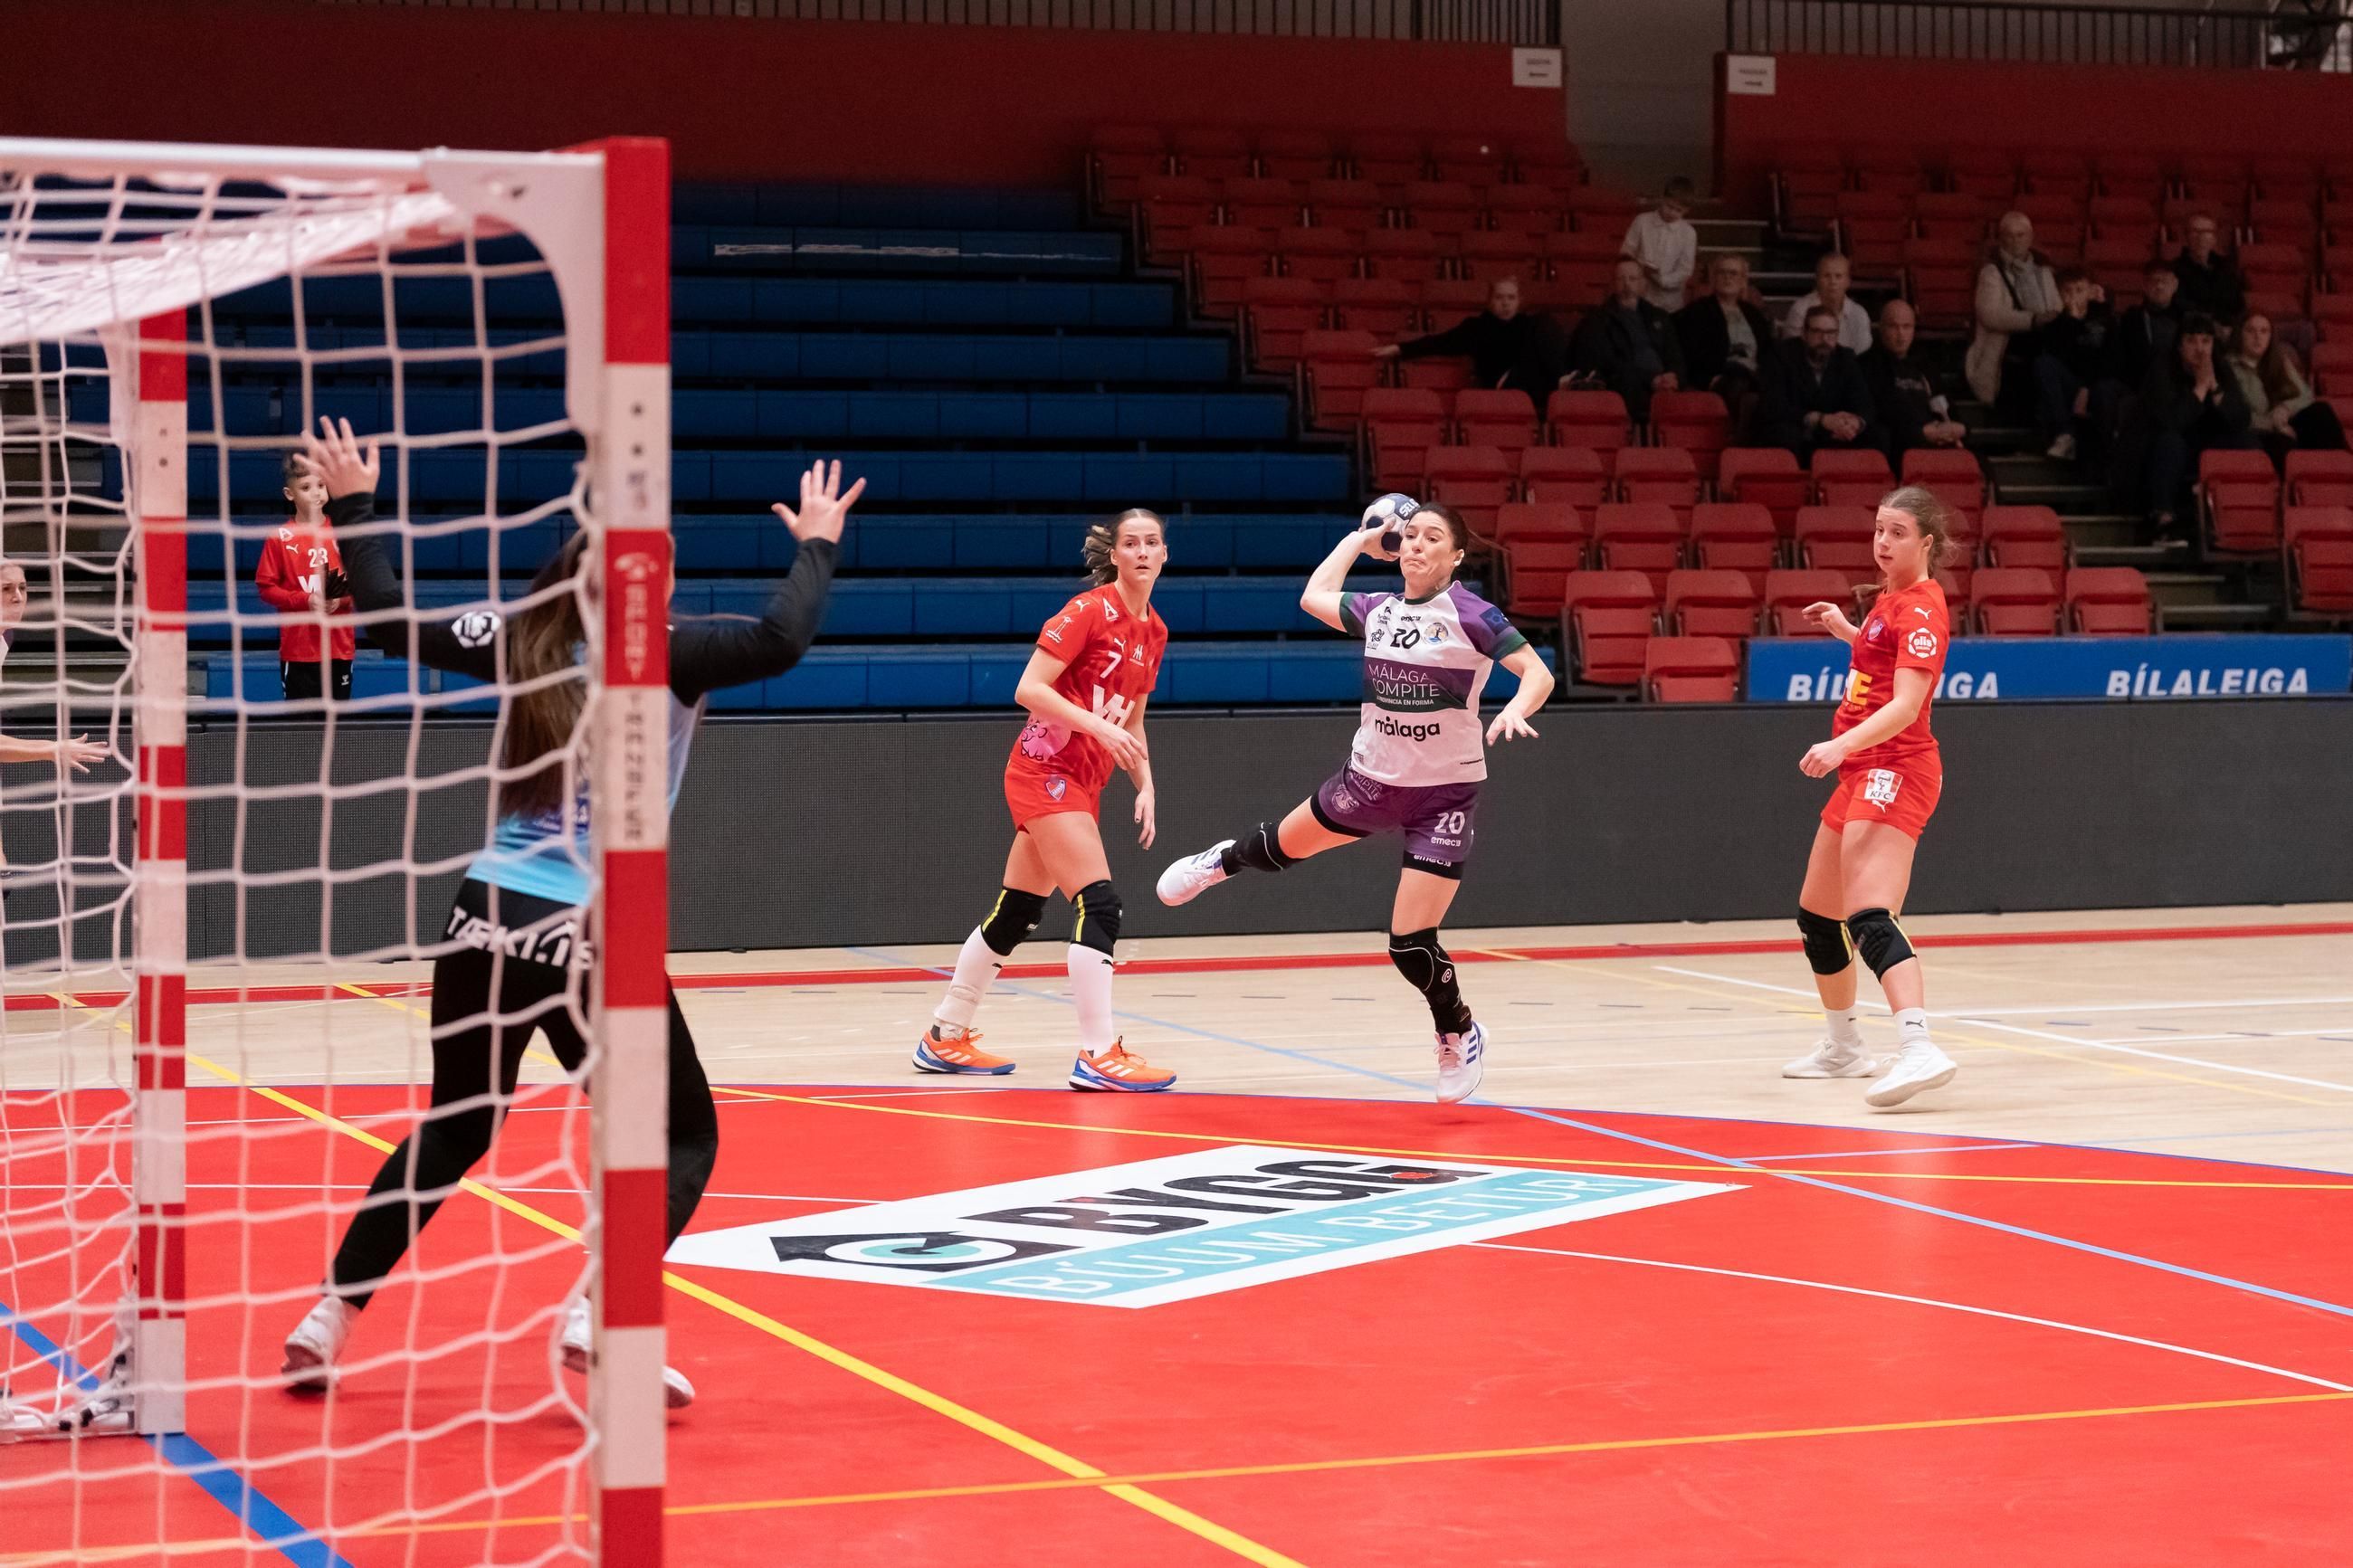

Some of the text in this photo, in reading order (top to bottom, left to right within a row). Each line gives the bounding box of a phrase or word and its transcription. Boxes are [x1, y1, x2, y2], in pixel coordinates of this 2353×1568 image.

[308, 547, 329, 568] 23
[1390, 628, 1420, 649] 20
[1100, 651, 1122, 679] 7
[1368, 663, 1430, 683] MÁLAGA
[1372, 678, 1440, 698] COMPITE
[2106, 662, 2308, 696] BÍLALEIGA
[1870, 791, 1891, 800] KFC
[1434, 811, 1466, 835] 20
[957, 1159, 1493, 1236] BYGG
[1317, 1178, 1644, 1231] BETUR
